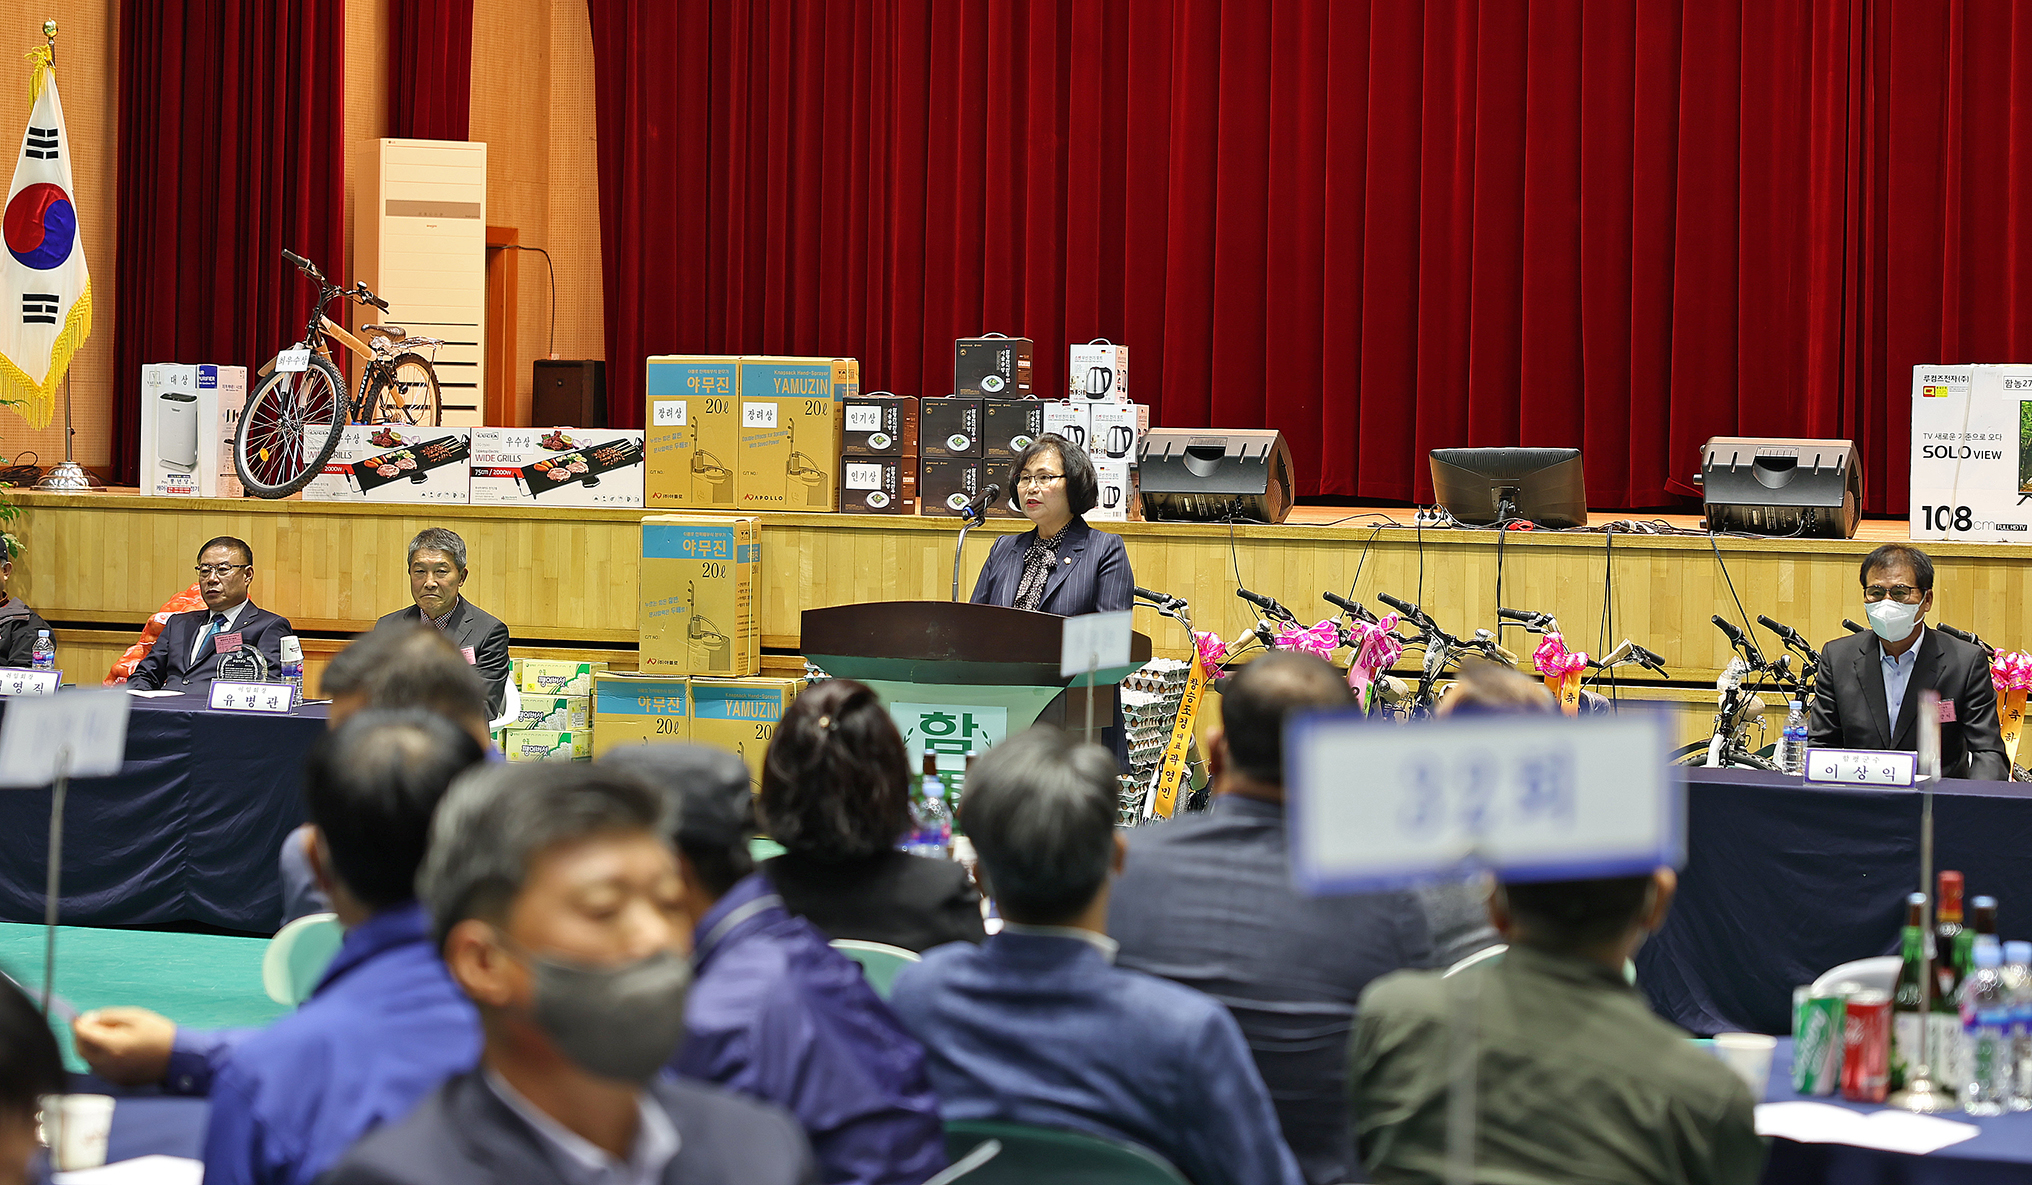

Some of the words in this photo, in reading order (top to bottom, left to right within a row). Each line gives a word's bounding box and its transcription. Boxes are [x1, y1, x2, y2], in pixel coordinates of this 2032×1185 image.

[278, 355, 307, 366] 최우수상
[687, 376, 729, 393] 야무진
[774, 378, 828, 394] YAMUZIN
[658, 407, 682, 419] 장려상
[748, 409, 772, 421] 장려상
[851, 412, 875, 424] 인기상
[340, 433, 360, 445] 수상
[506, 436, 530, 448] 우수상
[1935, 433, 1956, 441] 새로운
[1988, 433, 2002, 441] 오다
[1923, 445, 1971, 459] SOLO
[1973, 450, 2002, 460] VIEW
[851, 470, 876, 482] 인기상
[683, 539, 726, 557] 야무진
[0, 681, 44, 695] 영직
[223, 694, 279, 709] 유병관
[638, 695, 680, 713] 야무진
[725, 700, 779, 719] YAMUZIN
[920, 712, 979, 755] 함
[1825, 764, 1896, 782] 이상익
